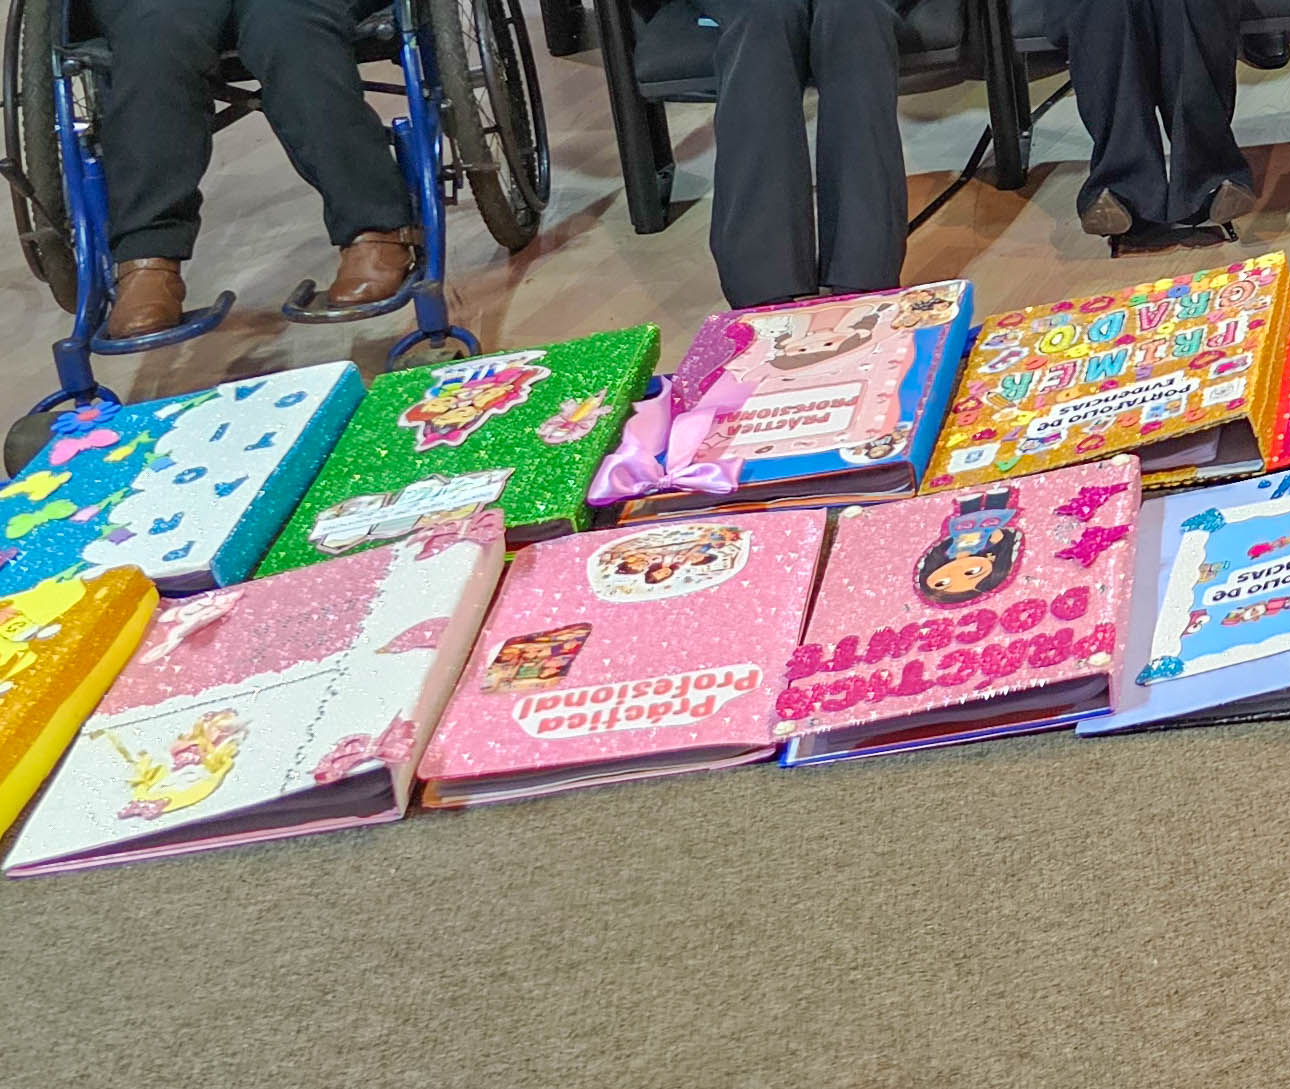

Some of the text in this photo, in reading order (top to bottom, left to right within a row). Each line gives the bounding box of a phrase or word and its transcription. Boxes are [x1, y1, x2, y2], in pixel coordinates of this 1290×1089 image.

[1038, 280, 1257, 356] GRADO
[1001, 321, 1238, 403] PRIMER
[518, 669, 759, 720] Profesional
[536, 695, 717, 734] Práctica
